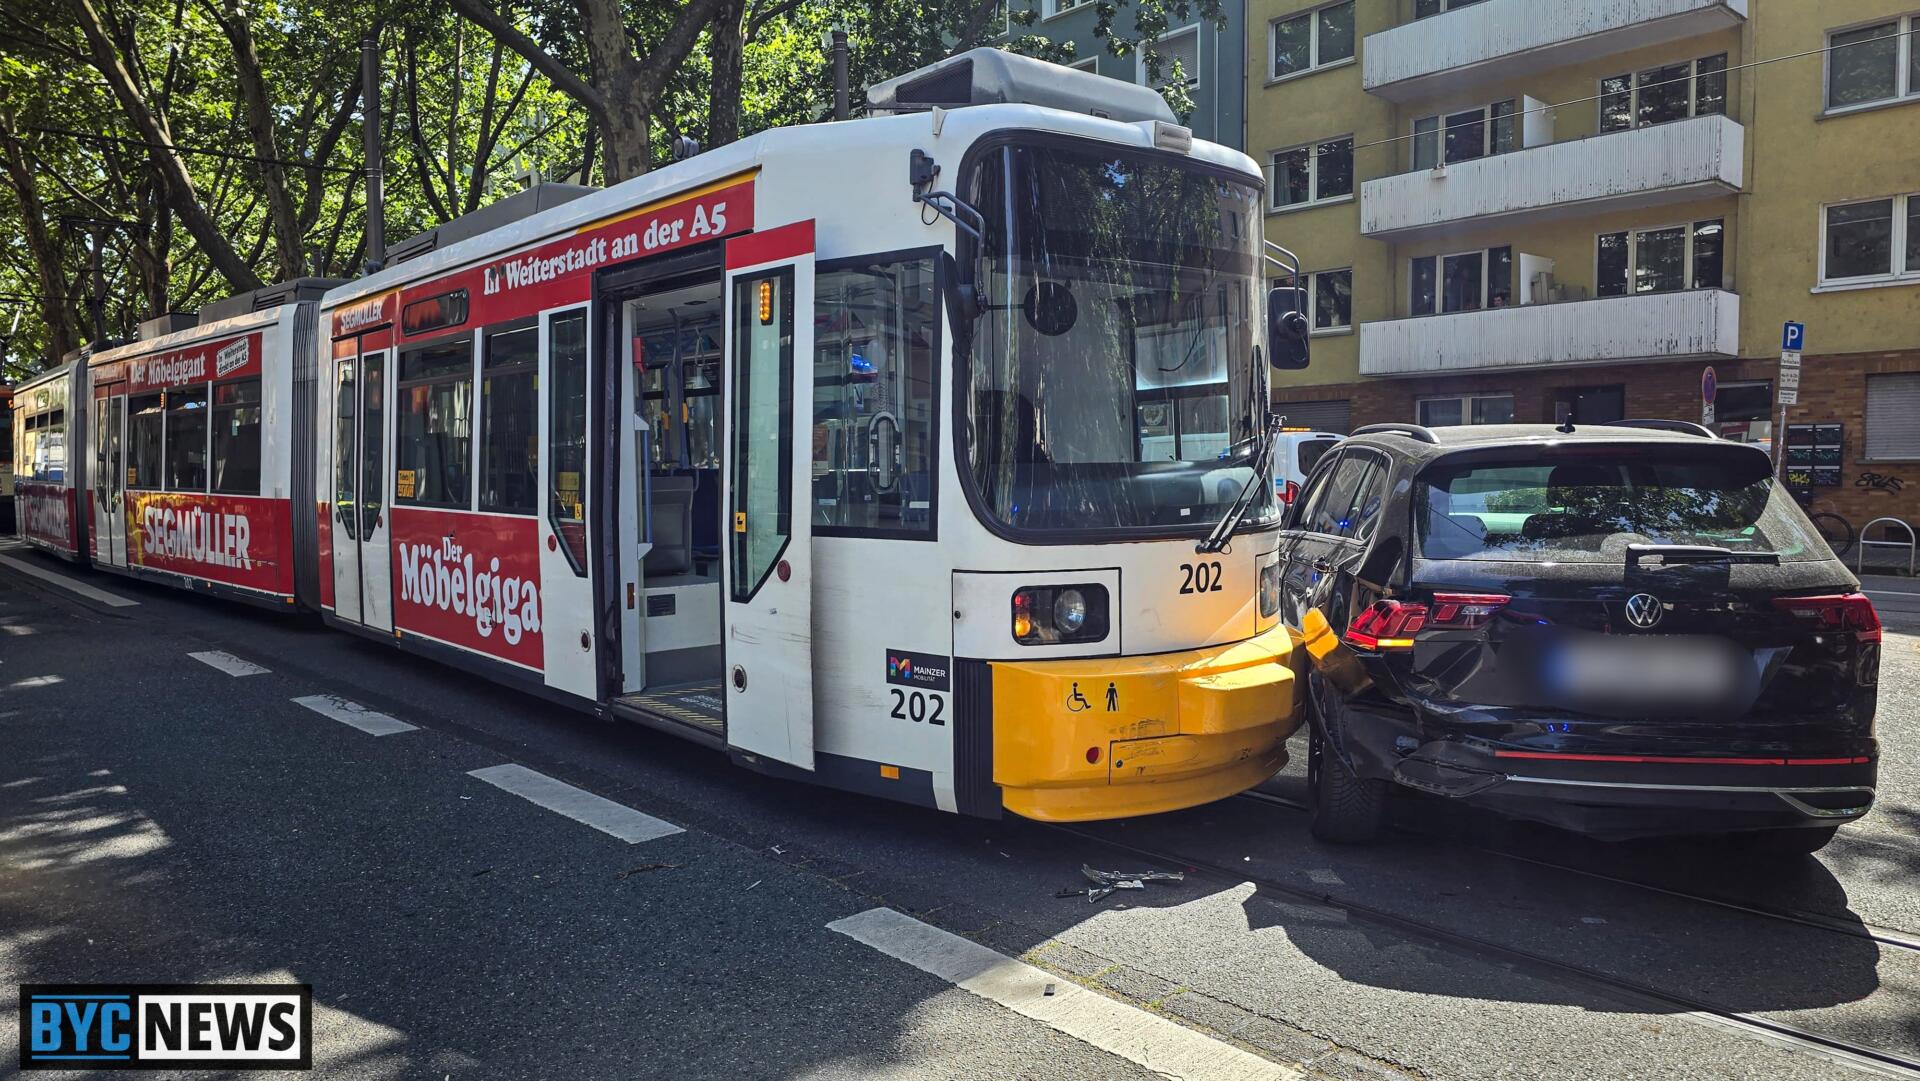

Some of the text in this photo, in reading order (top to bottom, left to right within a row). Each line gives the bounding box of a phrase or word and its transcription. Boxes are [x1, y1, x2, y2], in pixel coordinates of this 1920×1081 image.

[505, 237, 607, 290] Weiterstadt
[611, 233, 639, 260] an
[643, 218, 685, 250] der
[689, 201, 727, 238] A5
[1787, 326, 1799, 347] P
[130, 361, 146, 385] Der
[147, 351, 206, 387] Möbelgigant
[144, 505, 252, 571] SEGMÜLLER
[442, 536, 463, 564] Der
[400, 543, 543, 646] Möbelgiga
[1179, 561, 1223, 595] 202
[913, 665, 946, 678] MAINZER
[890, 688, 945, 726] 202
